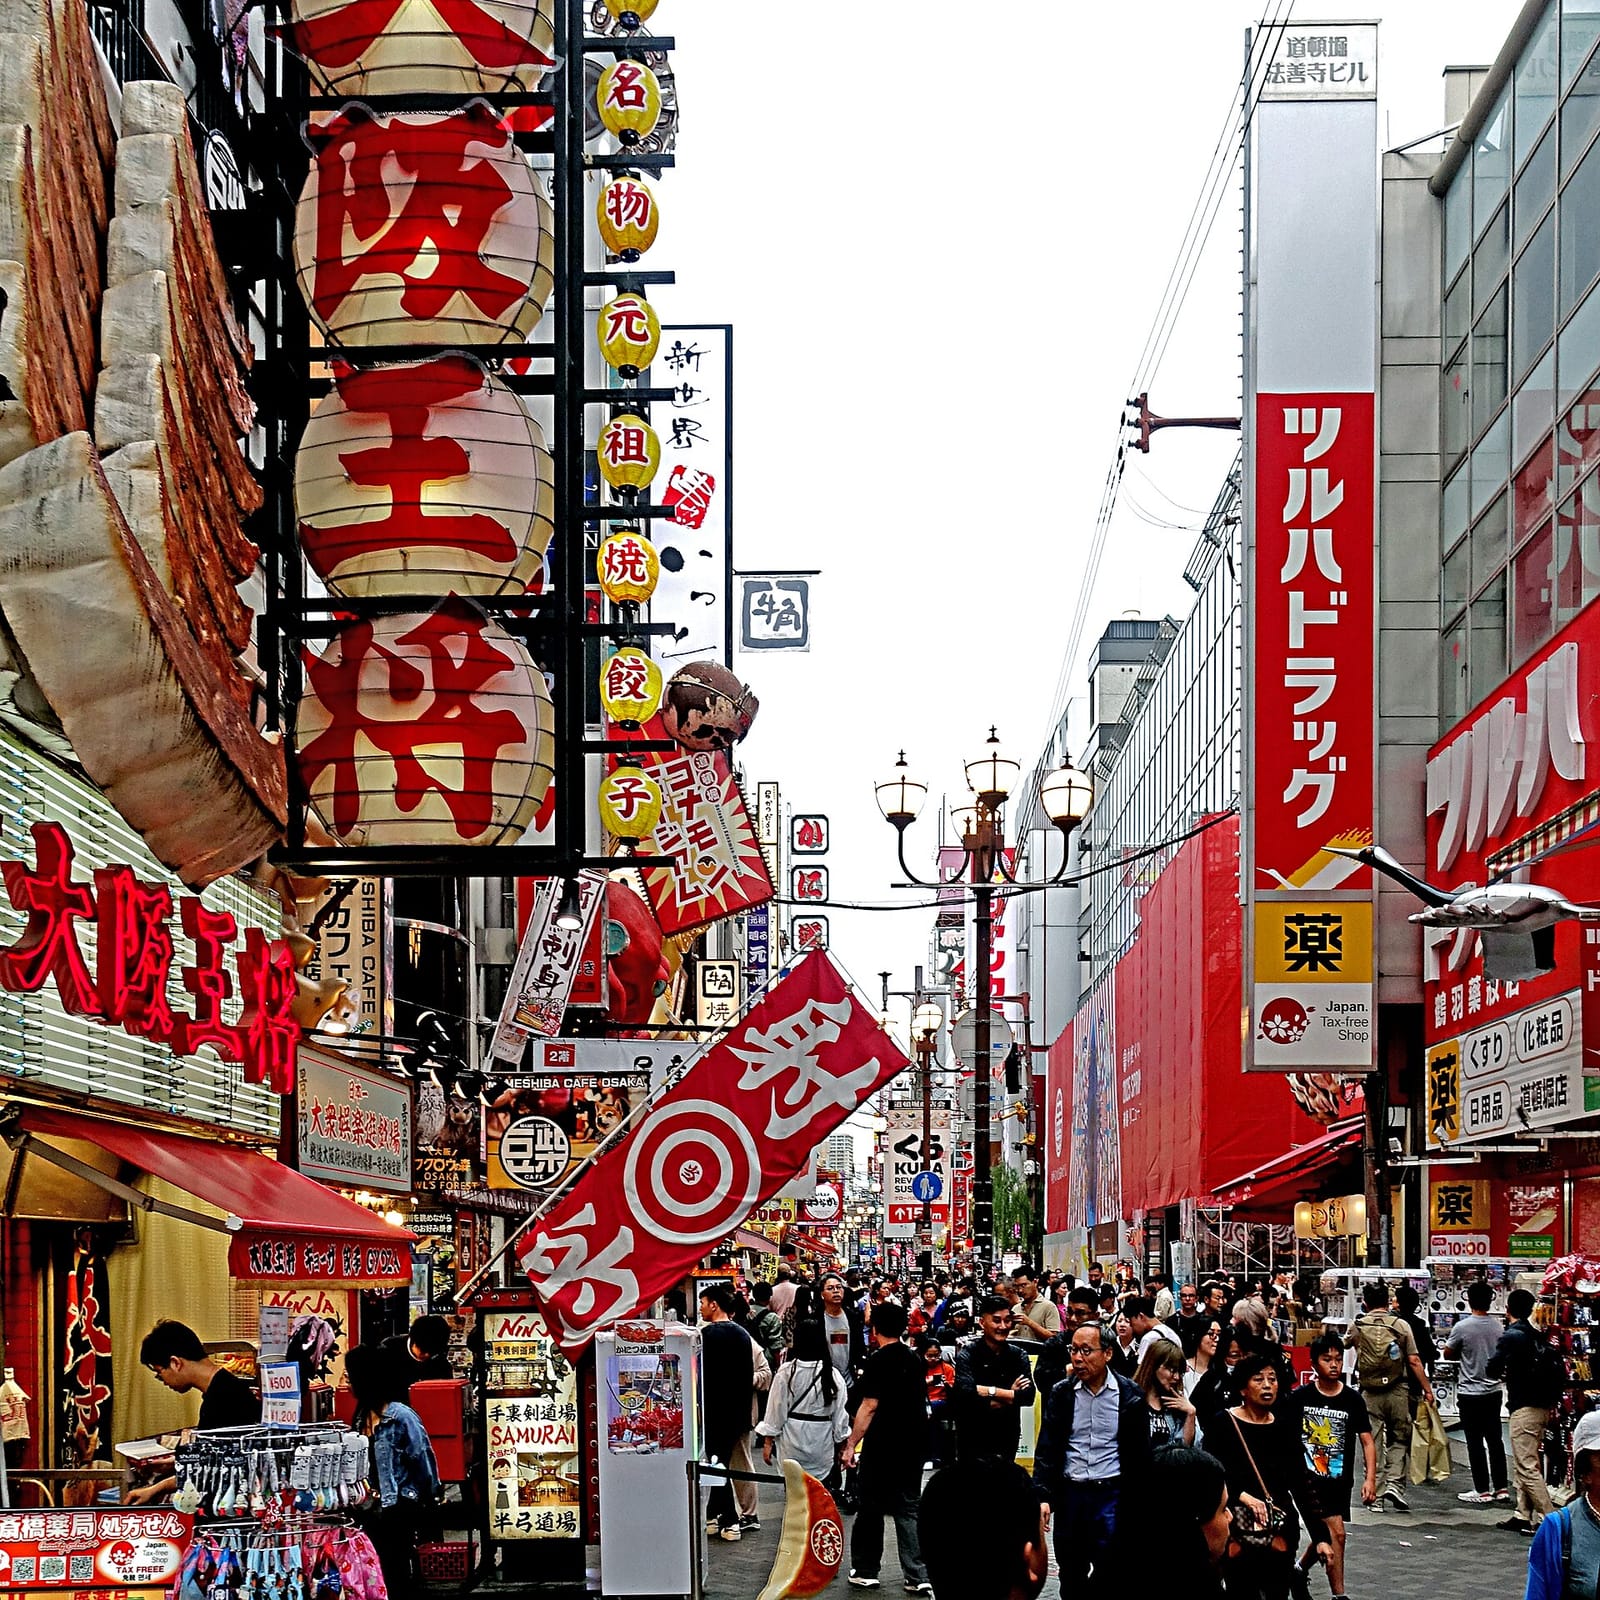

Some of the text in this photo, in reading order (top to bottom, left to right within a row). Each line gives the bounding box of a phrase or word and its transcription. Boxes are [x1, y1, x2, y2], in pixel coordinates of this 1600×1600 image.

[1287, 37, 1347, 57] 道頓堀
[1266, 62, 1368, 83] 法善寺ビル
[605, 62, 652, 819] 名物元祖焼餃子
[752, 592, 800, 632] 牛角
[1281, 408, 1346, 828] ツルハドラッグ
[1284, 913, 1342, 971] 薬
[0, 820, 297, 1094] 大阪王将
[362, 956, 376, 1014] CAFE
[705, 970, 731, 991] 牛角
[1325, 1001, 1368, 1013] Japan.
[1320, 1016, 1368, 1027] Tax-free
[1523, 1010, 1563, 1052] 化粧品
[1338, 1029, 1368, 1042] Shop
[1470, 1032, 1502, 1069] くすり
[563, 1078, 597, 1088] CAFE
[601, 1077, 646, 1088] OSAKA
[1431, 1053, 1457, 1132] 薬
[1470, 1092, 1503, 1125] 日用品
[424, 1172, 459, 1181] OSAKA
[1438, 1186, 1472, 1225] 薬
[366, 1247, 400, 1274] GYOZA
[270, 1376, 292, 1390] ¥500
[488, 1403, 577, 1422] 手裏剣道場
[491, 1426, 576, 1446] SAMURAI
[99, 1513, 185, 1540] 処方せん
[493, 1511, 577, 1533] 半弓道場
[136, 1565, 165, 1573] FREEE
